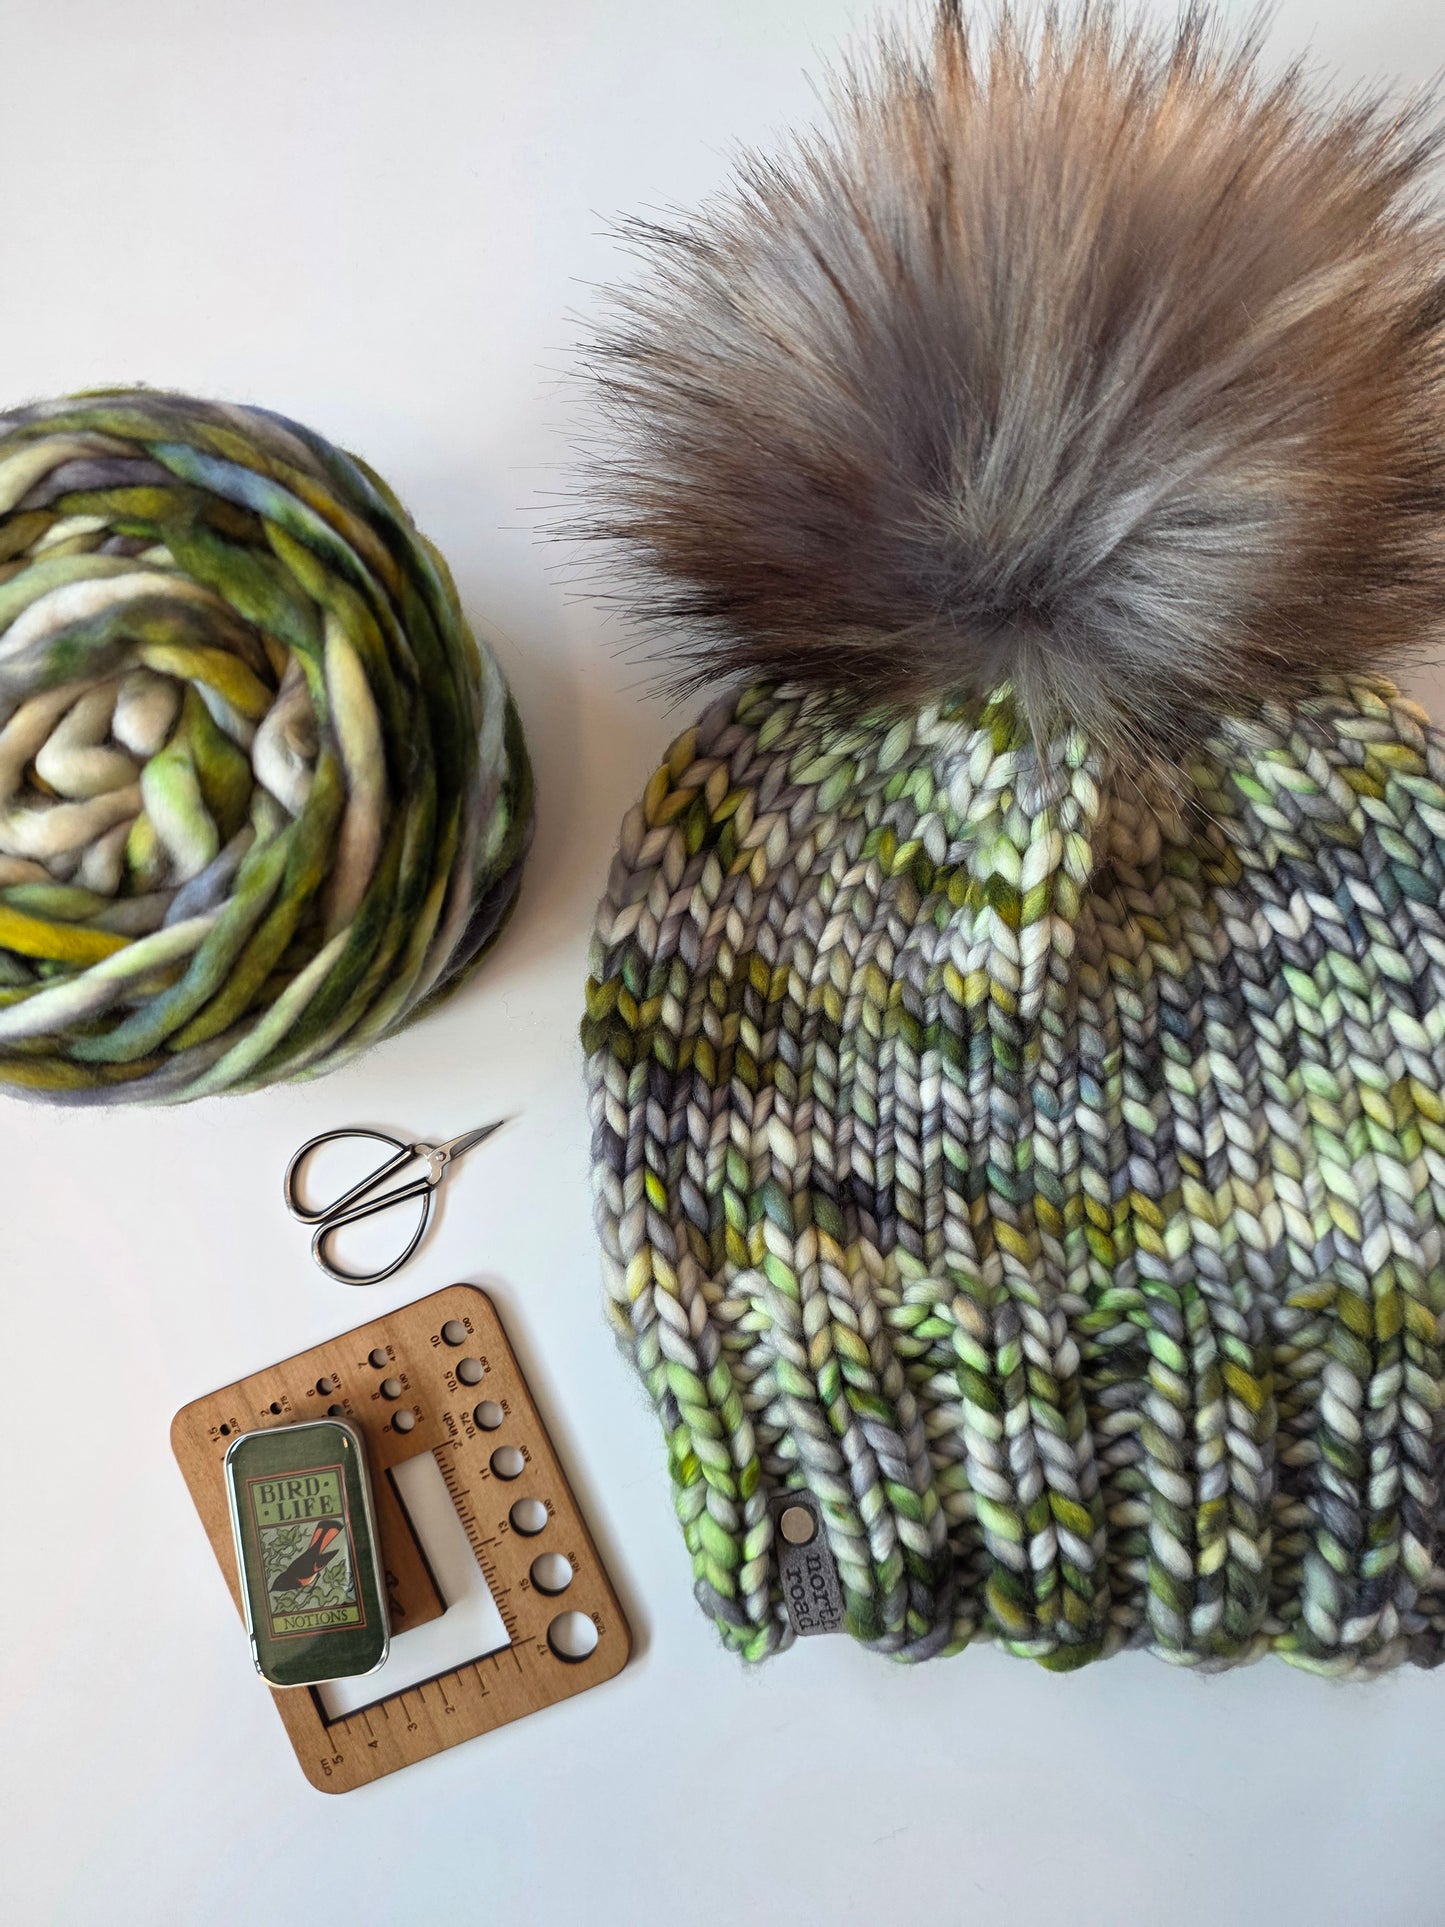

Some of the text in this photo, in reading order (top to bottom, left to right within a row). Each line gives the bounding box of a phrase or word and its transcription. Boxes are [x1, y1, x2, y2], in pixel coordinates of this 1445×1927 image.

[430, 1335, 441, 1348] 10
[443, 1371, 458, 1393] 10.5
[443, 1411, 463, 1450] 2 inch
[460, 1411, 476, 1440] 10.75
[480, 1467, 491, 1480] 11
[786, 1566, 820, 1631] road
[806, 1553, 841, 1632] north
[283, 1608, 348, 1631] NOTIONS
[536, 1643, 549, 1656] 17
[445, 1704, 456, 1714] 2
[407, 1722, 418, 1732] 3
[367, 1740, 379, 1749] 4
[320, 1758, 333, 1777] cm
[332, 1754, 344, 1765] 5
